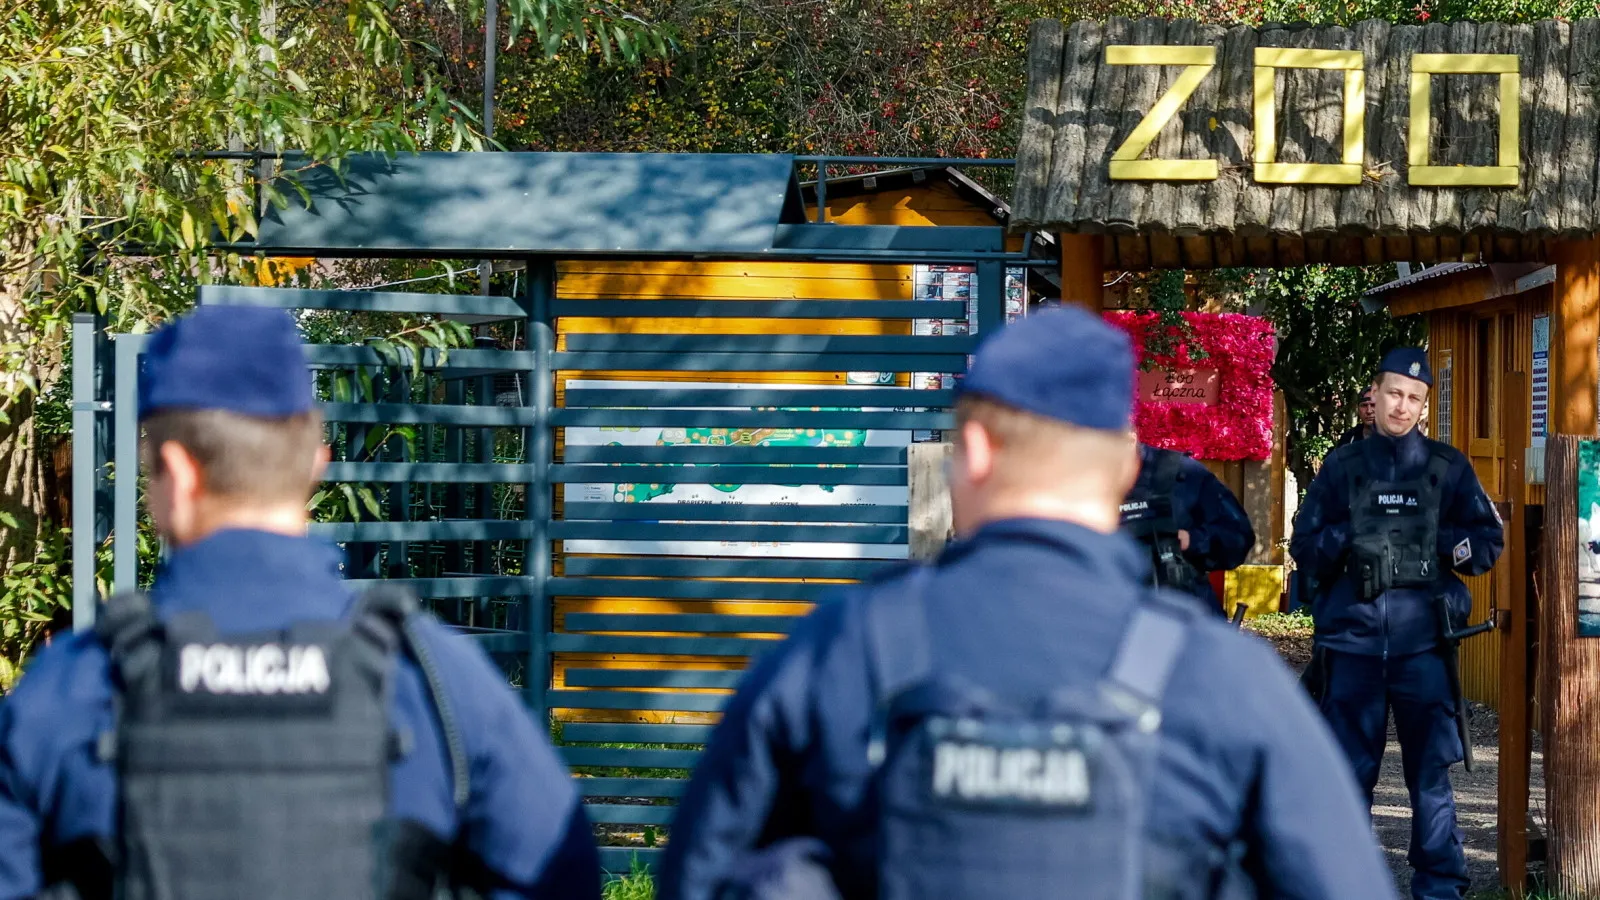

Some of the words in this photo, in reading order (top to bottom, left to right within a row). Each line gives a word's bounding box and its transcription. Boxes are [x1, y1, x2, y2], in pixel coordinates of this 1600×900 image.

[1105, 45, 1520, 186] ZOO
[1152, 383, 1206, 400] Łączna
[1119, 501, 1148, 512] POLICJA
[1378, 494, 1404, 505] POLICJA
[180, 643, 331, 694] POLICJA
[933, 741, 1090, 806] POLICJA
